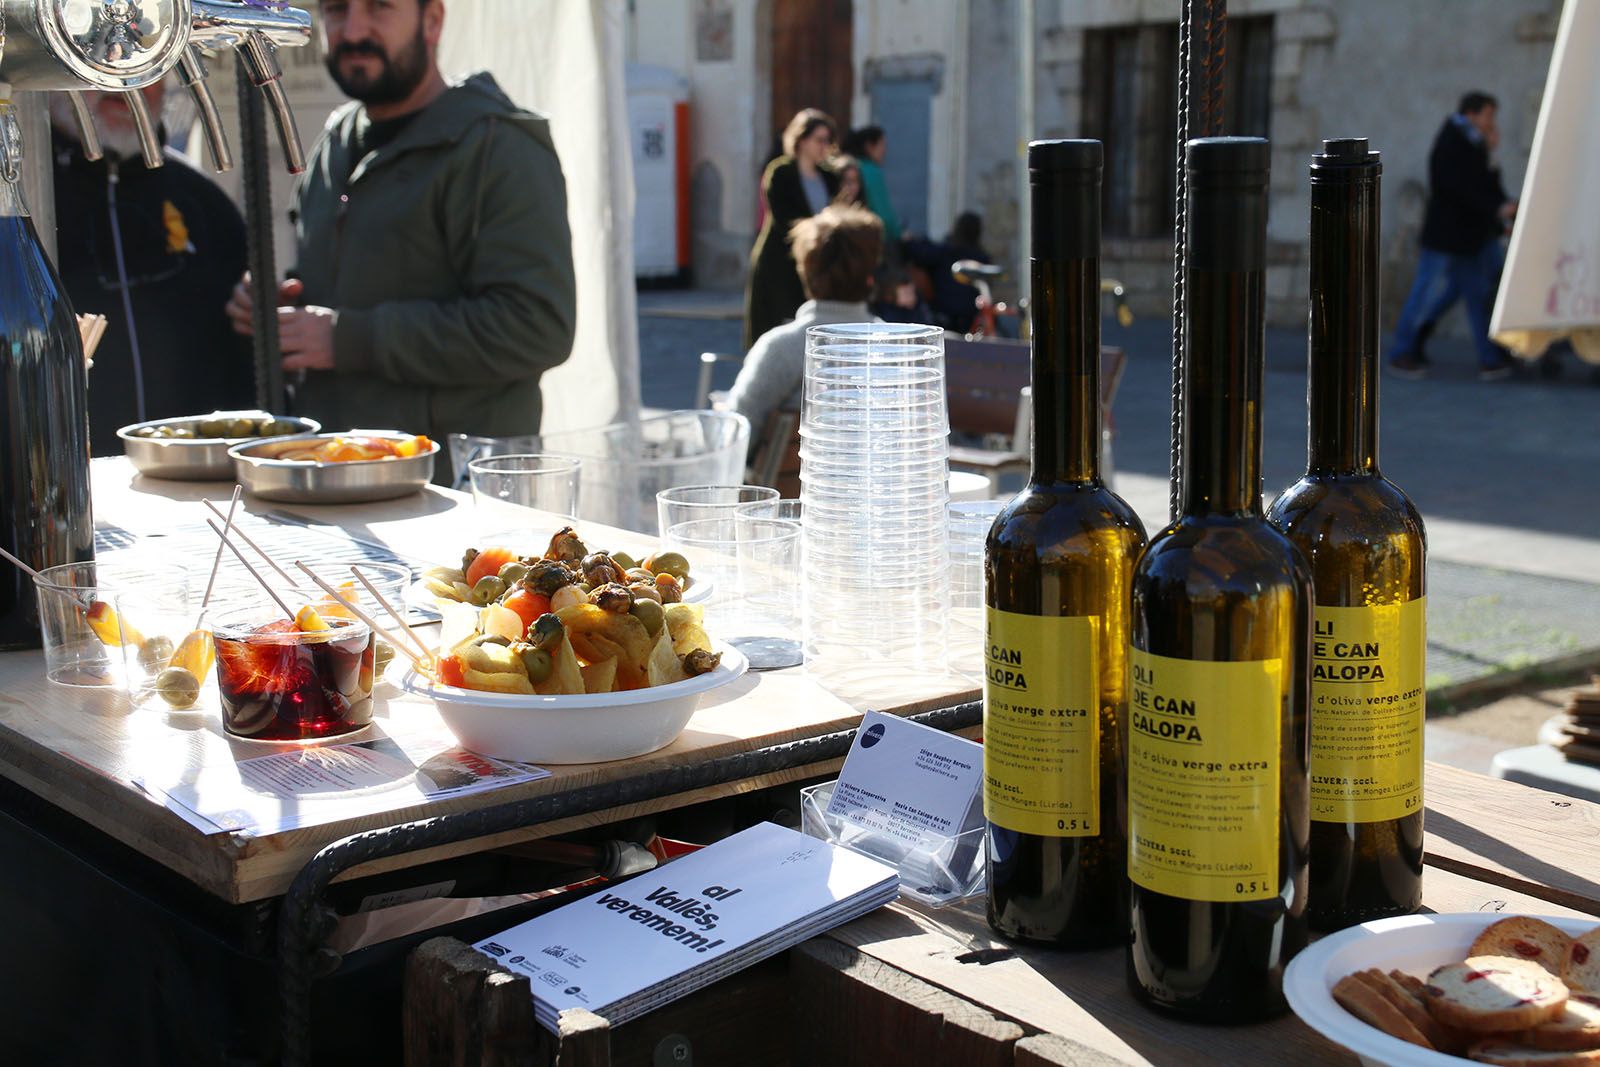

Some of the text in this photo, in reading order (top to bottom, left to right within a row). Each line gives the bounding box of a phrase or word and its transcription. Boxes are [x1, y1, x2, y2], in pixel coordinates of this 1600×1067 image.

[1314, 620, 1334, 636] LI
[991, 645, 1022, 665] CAN
[1314, 642, 1380, 658] E CAN
[986, 664, 1028, 689] LOPA
[1133, 665, 1153, 685] OLI
[1313, 664, 1385, 680] ALOPA
[1134, 688, 1196, 717] DE CAN
[1317, 695, 1362, 707] d'oliva
[1366, 693, 1400, 706] verge
[1011, 704, 1044, 717] verge
[1050, 708, 1087, 717] extra
[1330, 707, 1359, 716] Natural
[1133, 712, 1203, 742] CALOPA
[1143, 751, 1178, 767] d'oliva
[1182, 760, 1223, 773] verge
[1229, 760, 1268, 772] extra
[1312, 776, 1378, 786] LIVERA sccl.
[1311, 787, 1331, 795] bona
[1334, 787, 1344, 796] de
[1347, 787, 1361, 796] les
[1363, 786, 1391, 797] Monges
[1405, 795, 1417, 809] 0.5
[1057, 820, 1090, 830] 0.5 L
[702, 885, 744, 902] al
[1235, 881, 1270, 894] 0.5 L
[644, 886, 721, 932] Vallès,
[595, 893, 727, 954] veremem!
